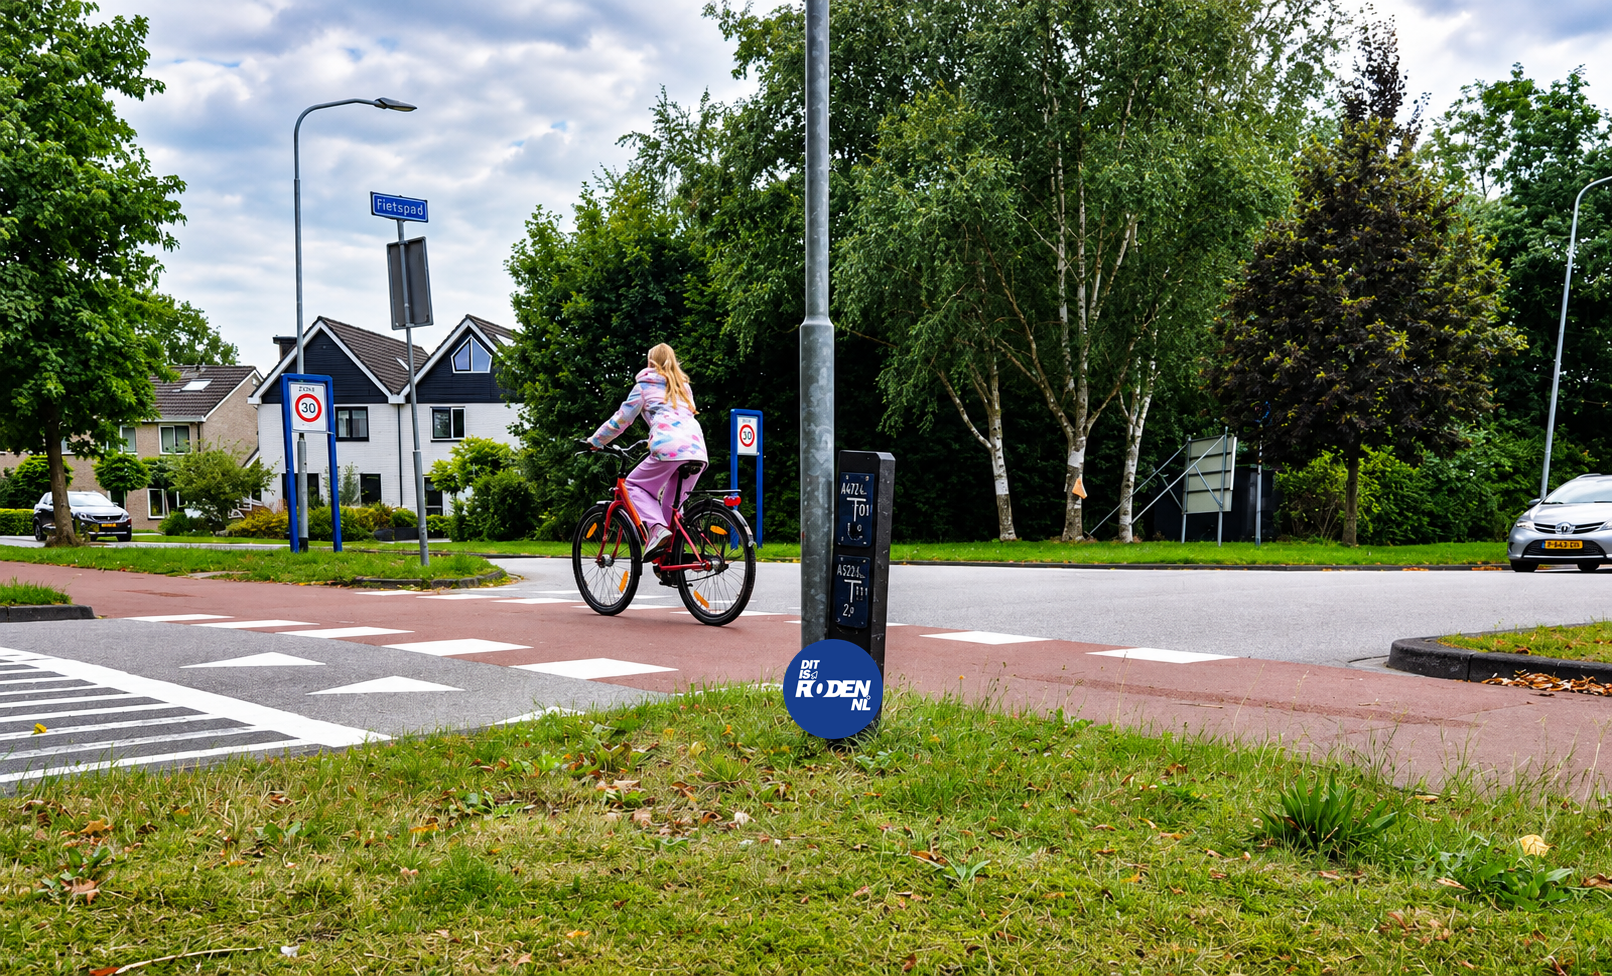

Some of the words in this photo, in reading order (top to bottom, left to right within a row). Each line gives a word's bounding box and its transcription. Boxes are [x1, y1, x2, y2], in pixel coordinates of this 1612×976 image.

[377, 198, 424, 216] Fietspad
[301, 402, 316, 413] 30
[742, 431, 753, 441] 30
